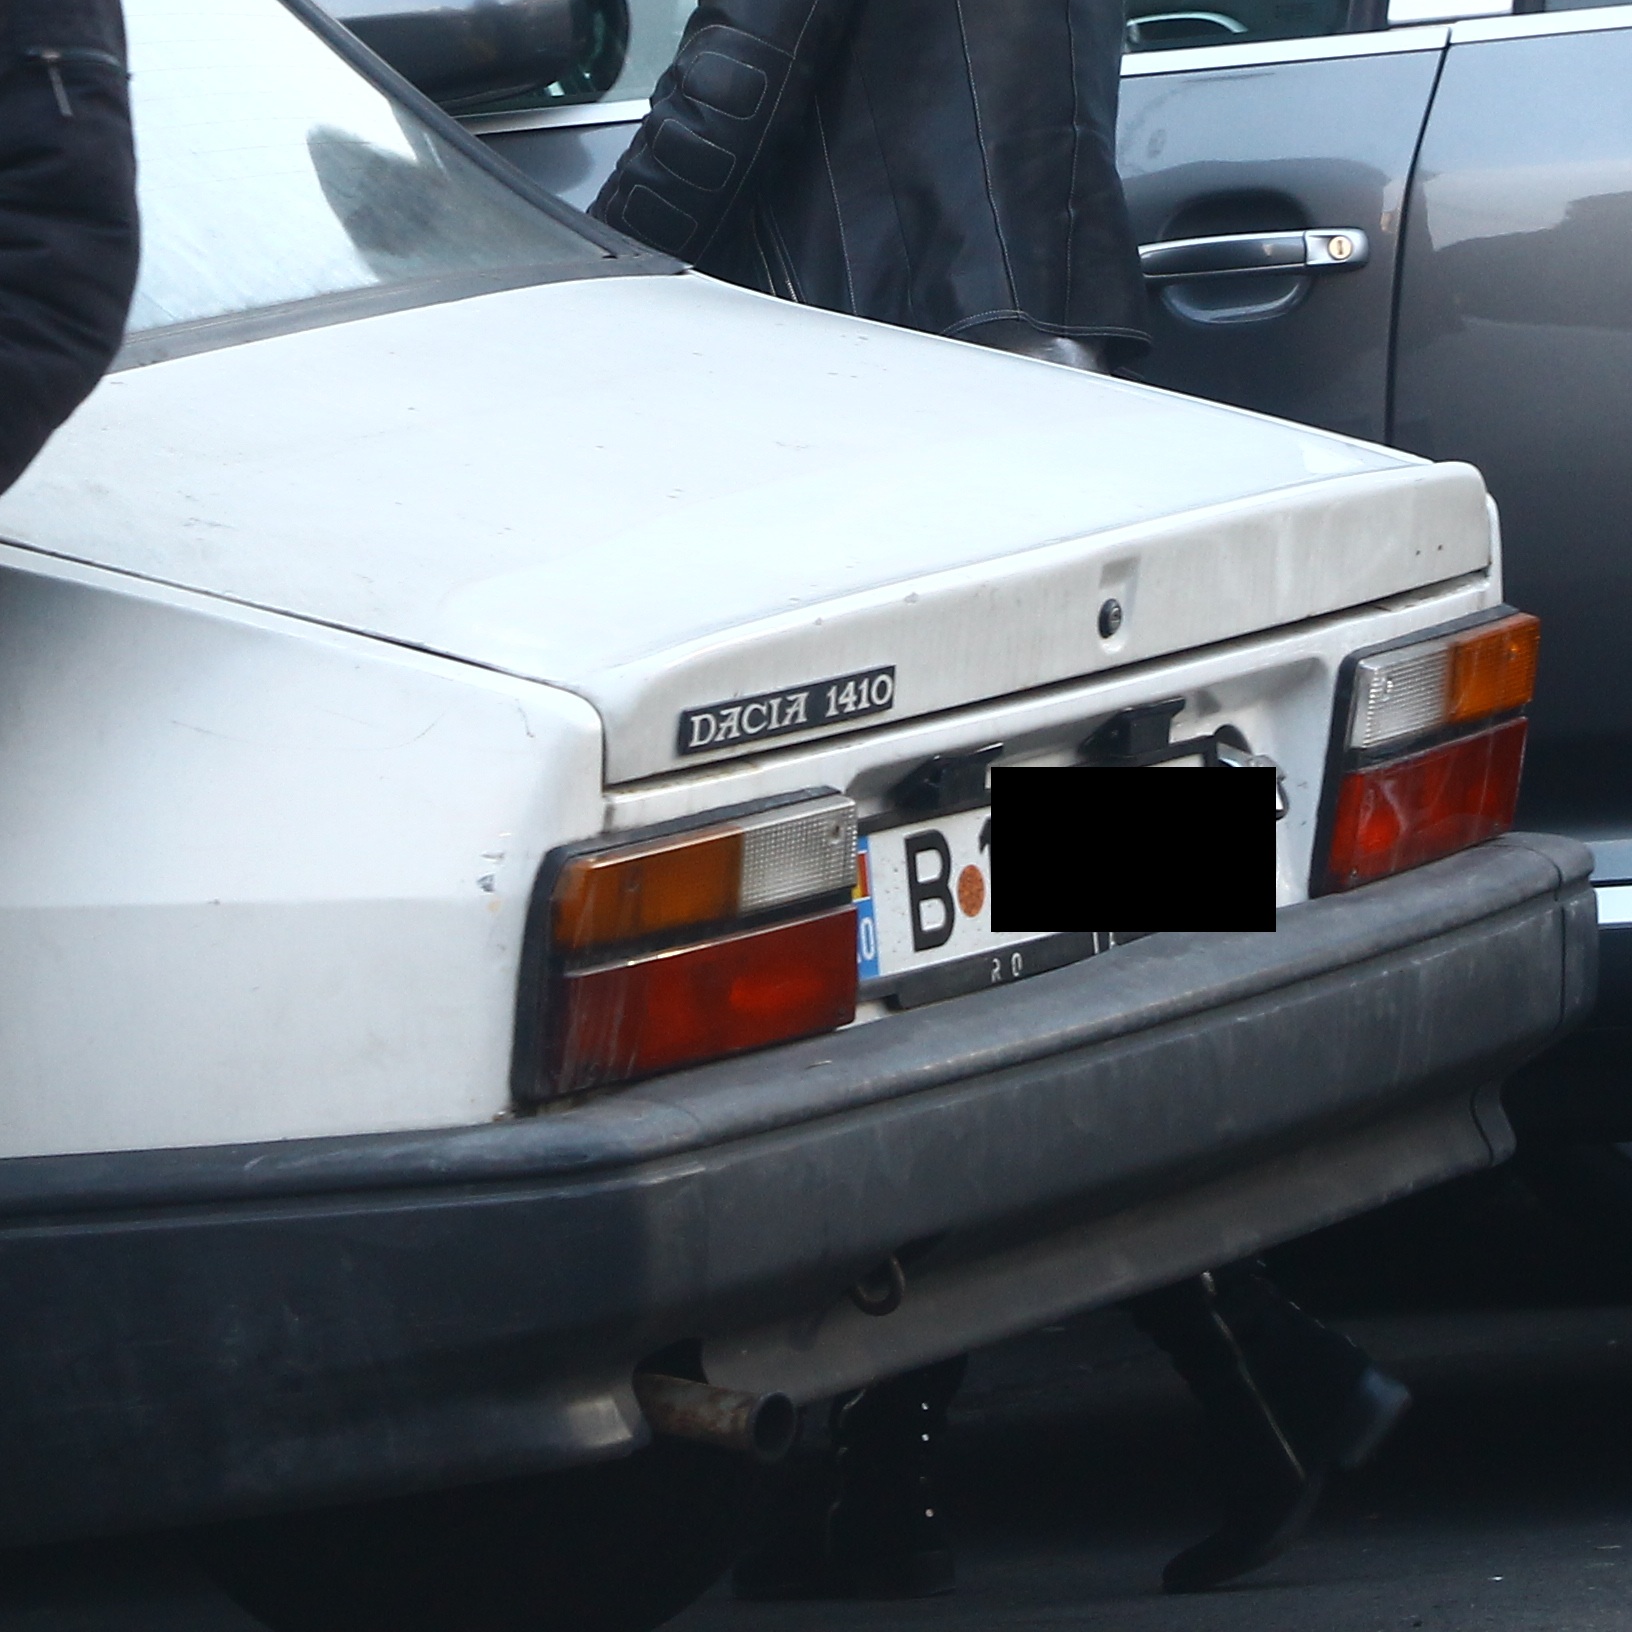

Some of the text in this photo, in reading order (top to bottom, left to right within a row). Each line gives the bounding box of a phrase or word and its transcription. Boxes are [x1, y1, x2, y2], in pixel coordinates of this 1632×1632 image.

[689, 674, 893, 747] DACIA 1410
[904, 829, 955, 953] B
